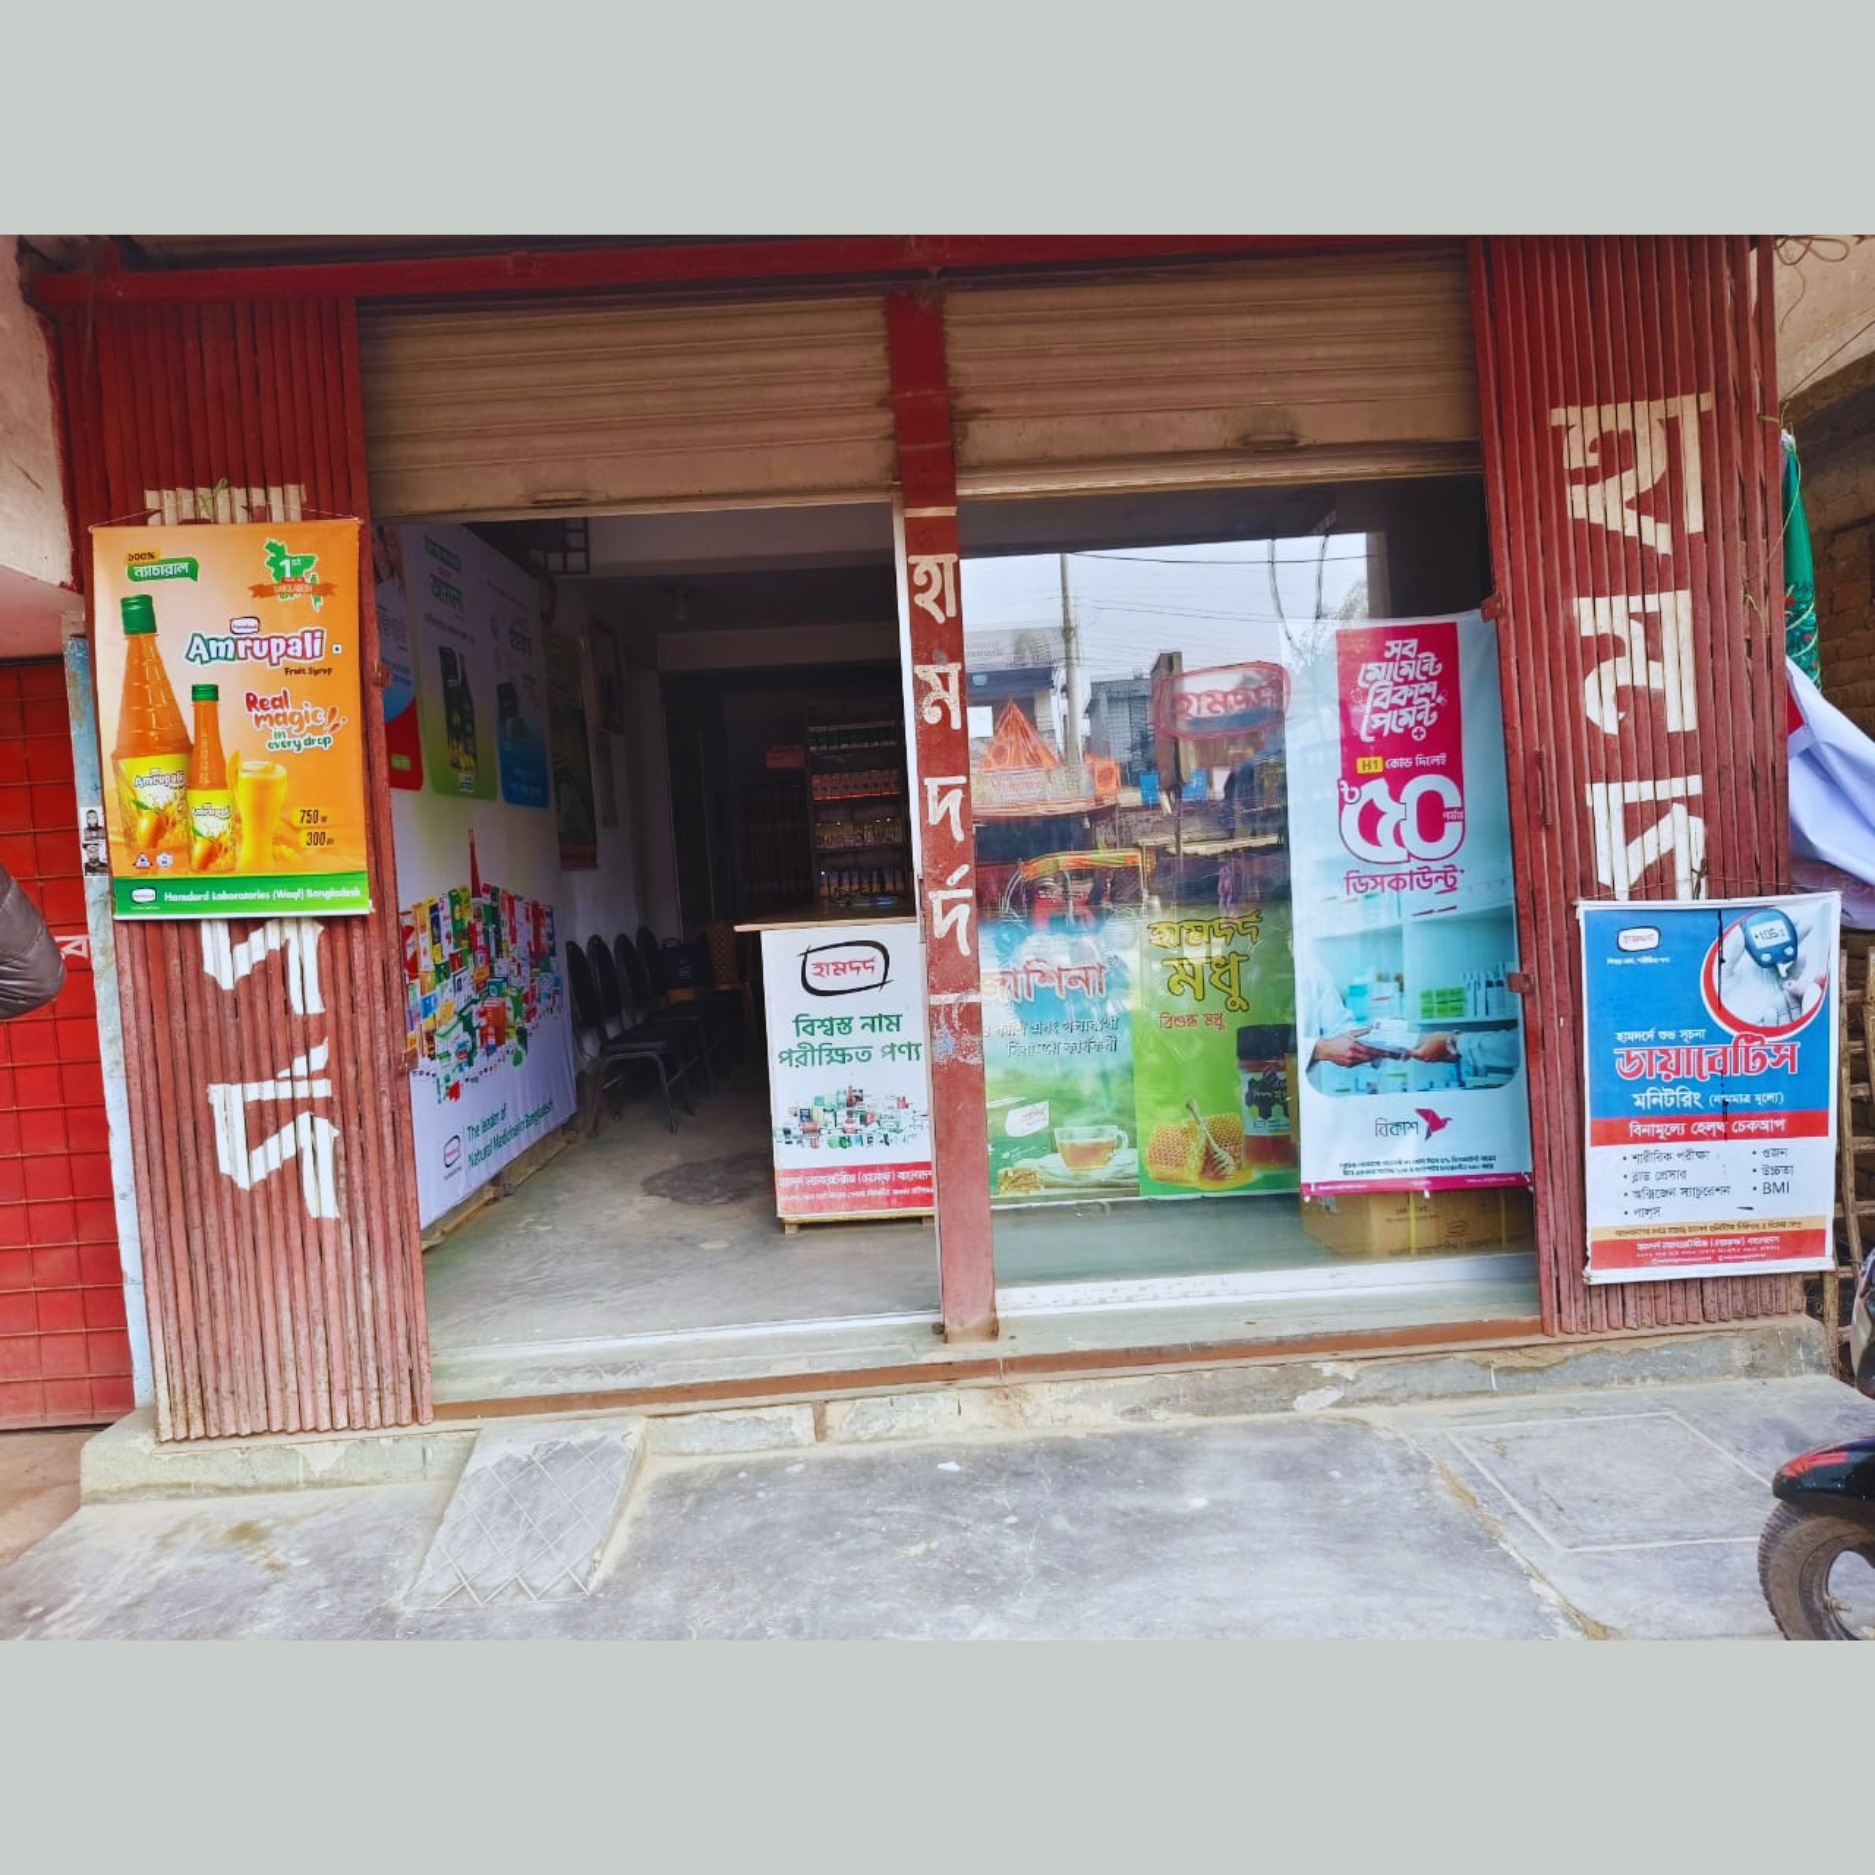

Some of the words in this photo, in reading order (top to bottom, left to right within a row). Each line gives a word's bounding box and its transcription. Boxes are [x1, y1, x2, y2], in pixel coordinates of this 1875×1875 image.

[133, 562, 189, 577] ন্যাচারাল
[187, 629, 325, 667] Amrupali
[1384, 638, 1418, 665] সব
[245, 689, 289, 713] Real
[1368, 680, 1438, 710] বিকাশ
[267, 739, 302, 752] every
[303, 736, 332, 749] drop
[1361, 760, 1379, 771] H1
[1385, 757, 1413, 769] কোড
[300, 809, 319, 824] 750
[306, 831, 326, 846] 300
[811, 956, 877, 978] হামদর্দ
[1162, 951, 1250, 1012] মধু
[792, 1013, 853, 1038] বিশ্বস্ত
[860, 1012, 903, 1033] নাম
[778, 1042, 874, 1068] পরীক্ষিত
[880, 1041, 923, 1063] পণ্য
[1613, 1032, 1801, 1081] ডায়াবেটিস
[1631, 1085, 1704, 1110] মনিটরিং
[1375, 1117, 1419, 1138] বিকাশ
[1629, 1120, 1688, 1141] বিনামূল্যে
[1732, 1118, 1787, 1134] চেকআপ
[1762, 1182, 1790, 1195] BMI
